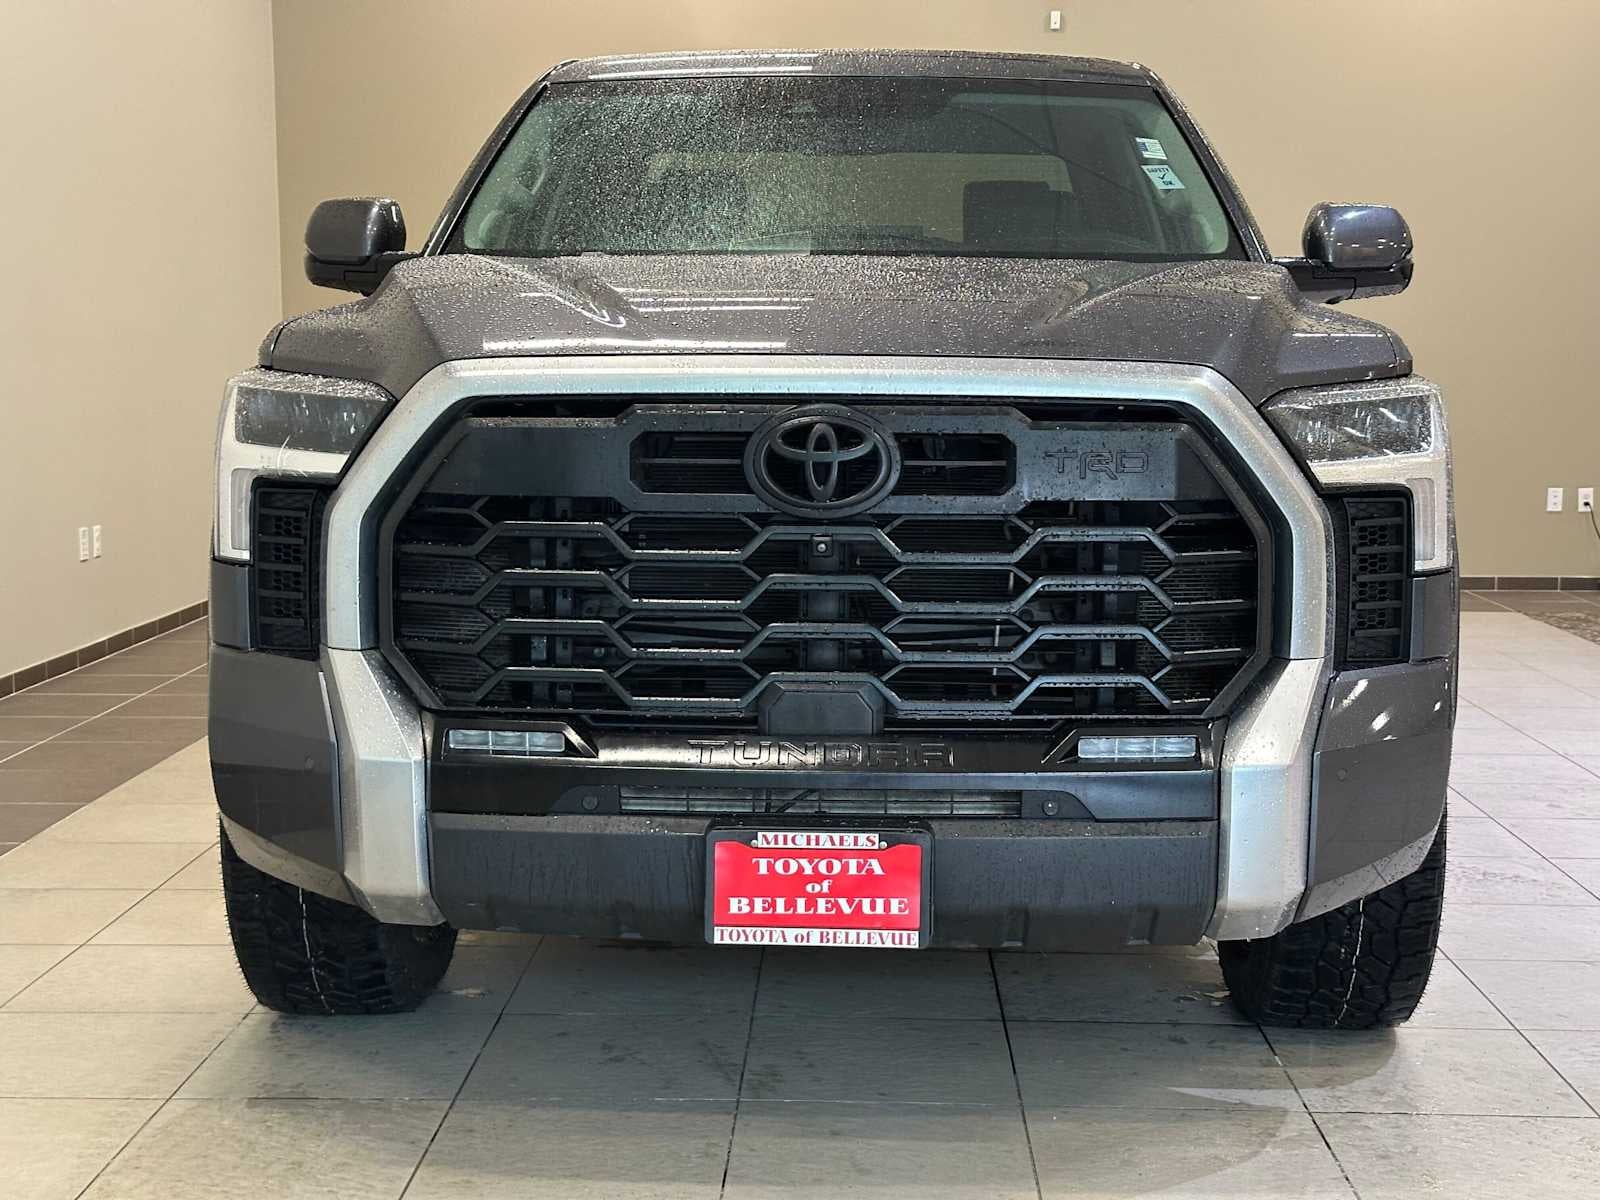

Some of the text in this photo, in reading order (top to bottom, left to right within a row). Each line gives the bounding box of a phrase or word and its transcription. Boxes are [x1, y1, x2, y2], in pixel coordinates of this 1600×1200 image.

[1043, 450, 1149, 480] TRD
[688, 738, 955, 767] TUNDRA
[760, 832, 877, 848] MICHAELS
[752, 857, 885, 876] TOYOTA
[805, 879, 833, 894] of
[728, 897, 910, 915] BELLEVUE
[716, 928, 918, 947] TOYOTA of BELLEVUE
